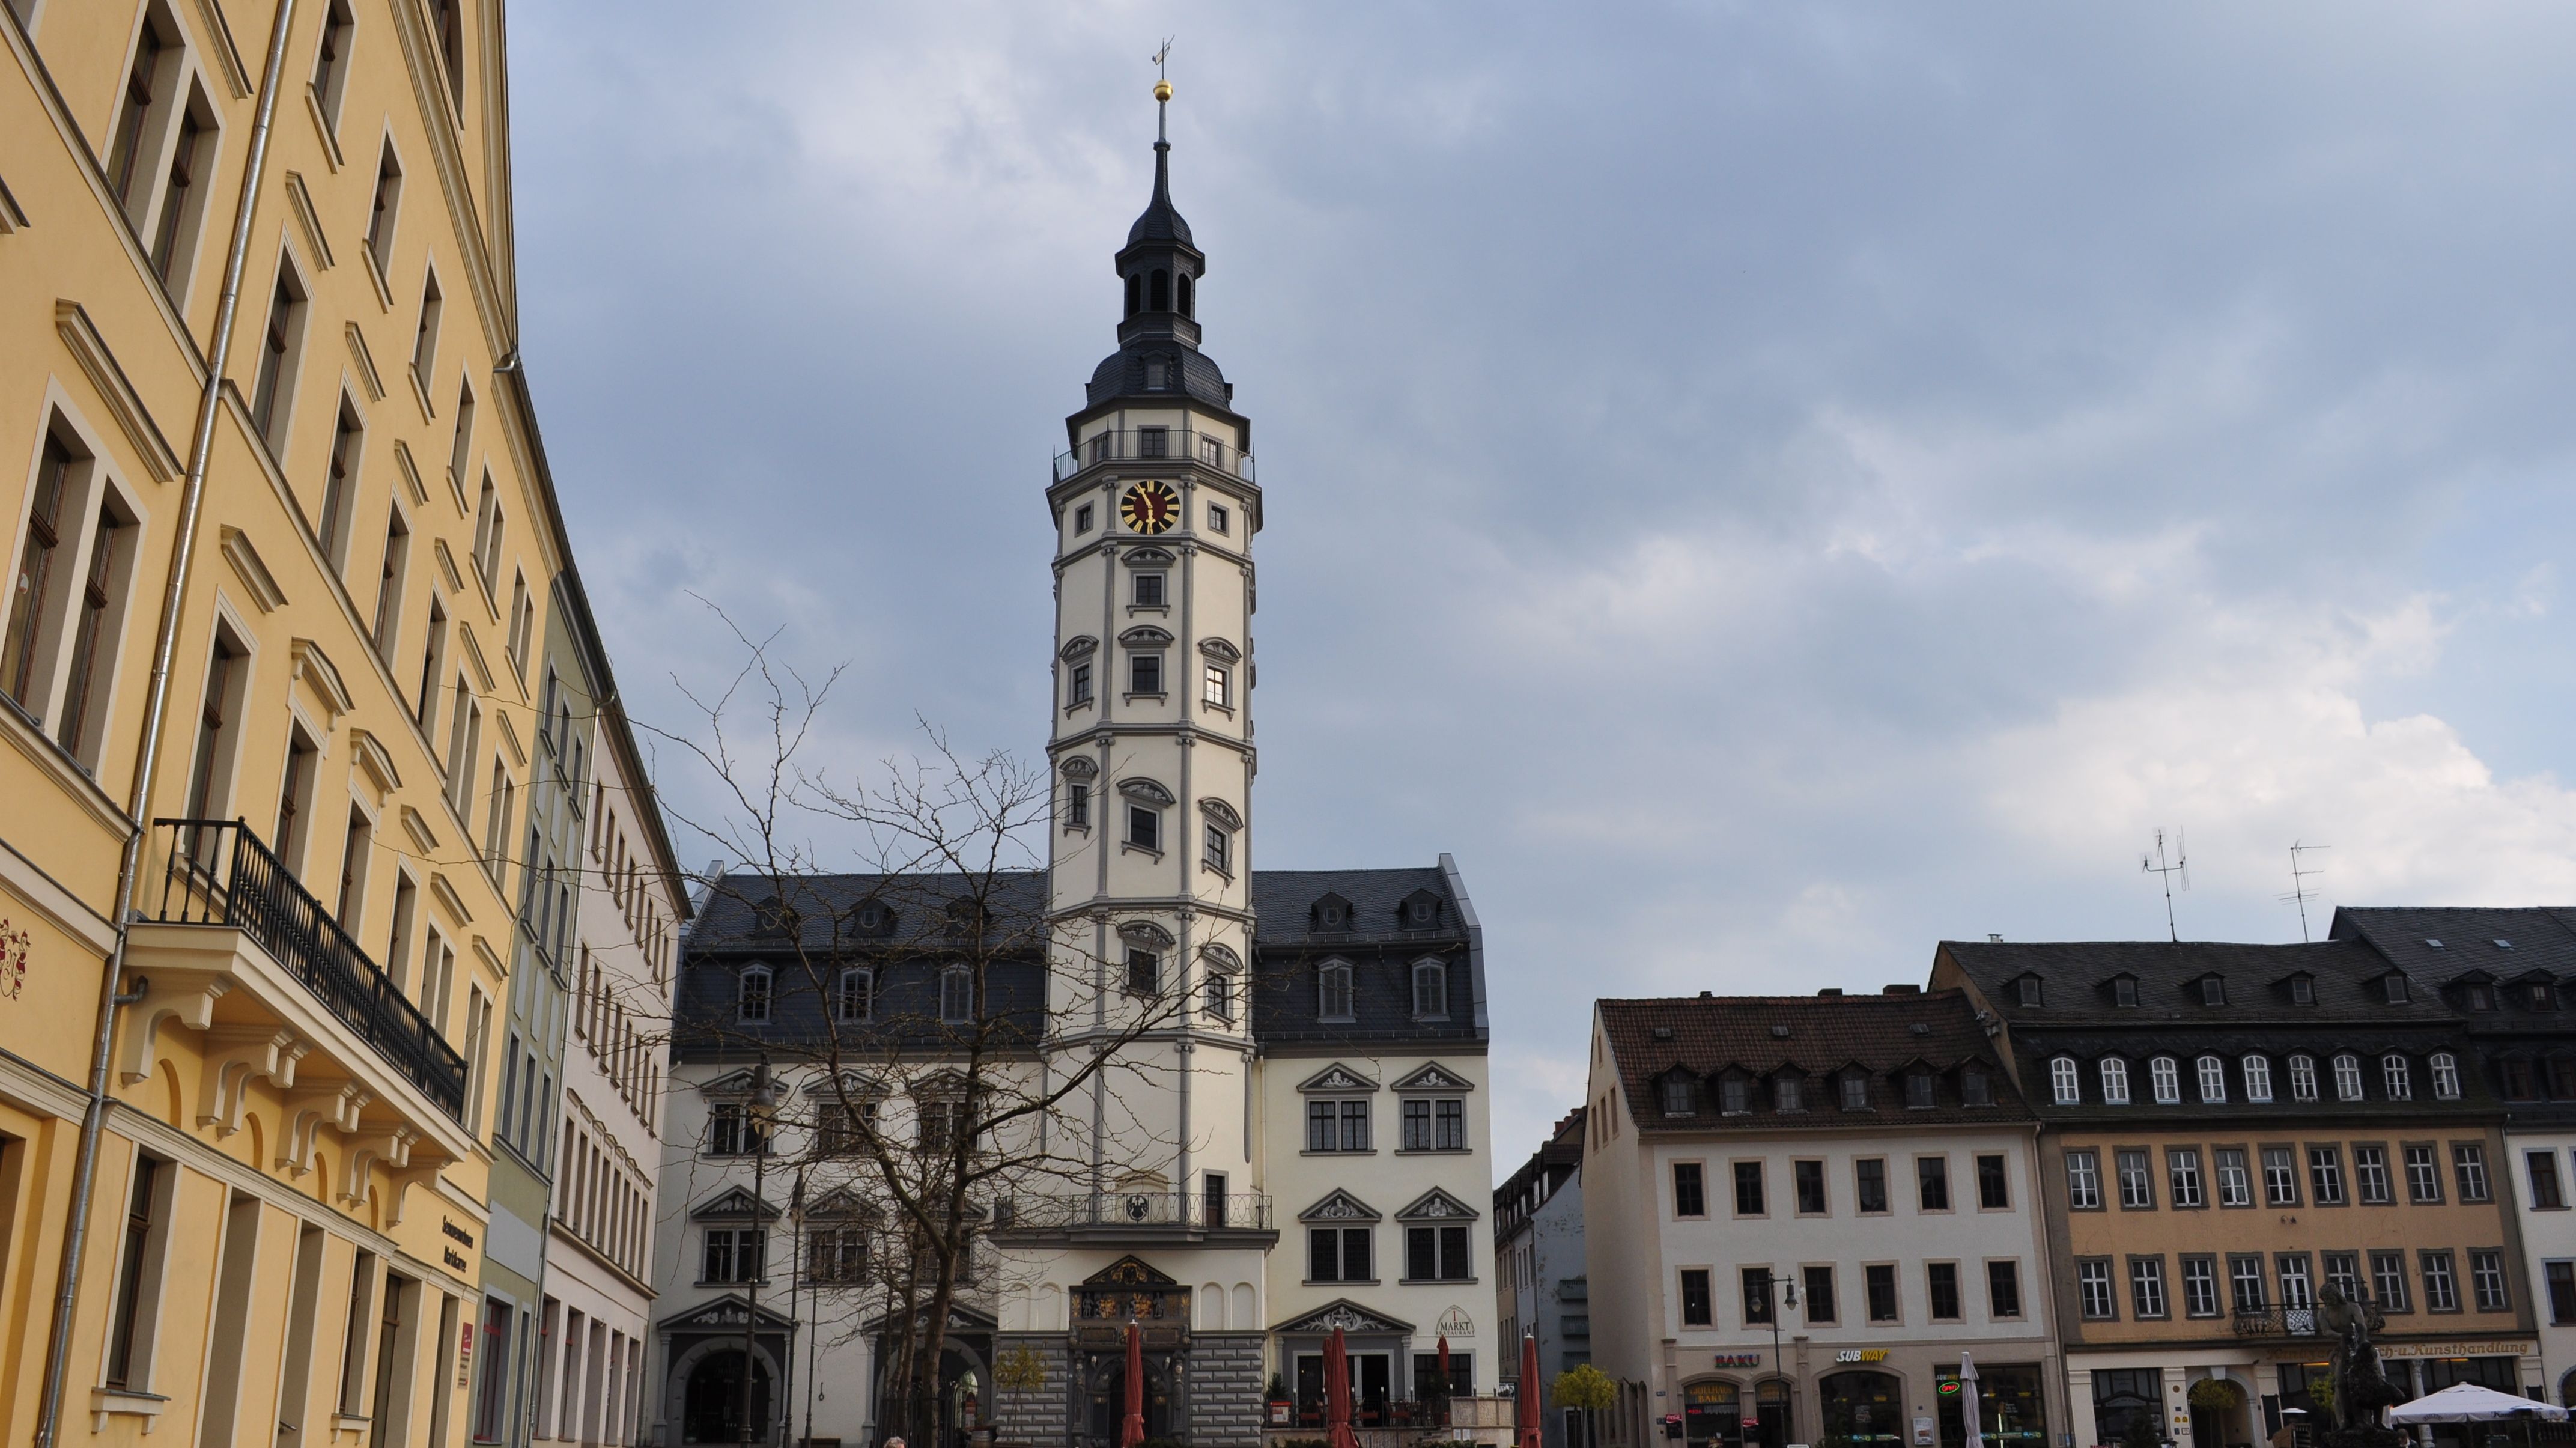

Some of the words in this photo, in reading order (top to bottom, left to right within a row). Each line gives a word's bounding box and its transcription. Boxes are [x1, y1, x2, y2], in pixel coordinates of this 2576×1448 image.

[1441, 1322, 1469, 1331] MARKT
[1715, 1354, 1760, 1368] BAKU
[1836, 1349, 1891, 1363] SUBWAY
[1698, 1395, 1725, 1403] BAKU
